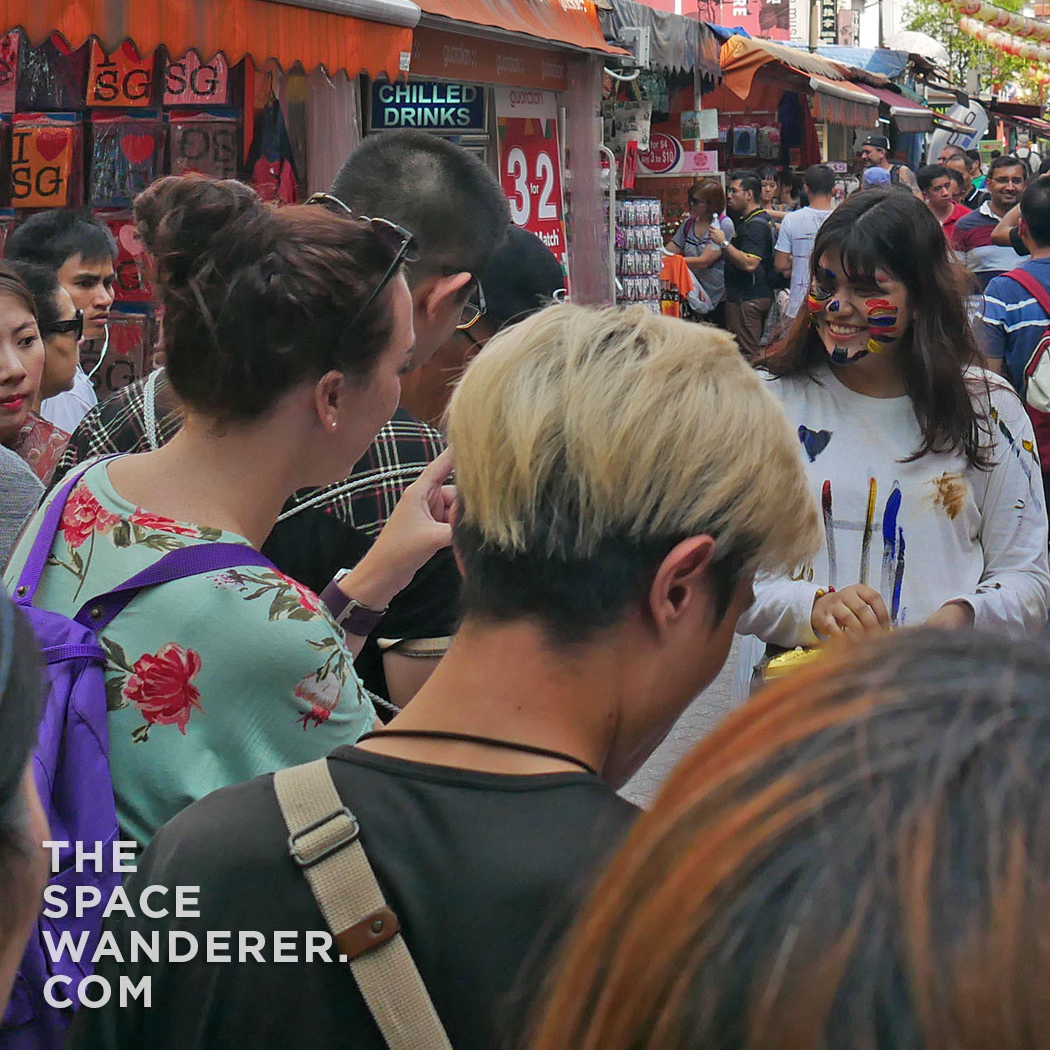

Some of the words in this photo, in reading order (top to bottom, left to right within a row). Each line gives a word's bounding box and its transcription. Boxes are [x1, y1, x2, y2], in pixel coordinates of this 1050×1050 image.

[94, 69, 152, 102] SG
[165, 63, 220, 96] SG
[378, 84, 477, 105] CHILLED
[510, 89, 544, 108] guardian
[384, 106, 471, 127] DRINKS
[12, 132, 32, 165] I
[11, 166, 64, 199] SG
[507, 147, 532, 229] 3
[530, 182, 540, 195] for
[535, 151, 559, 221] 2
